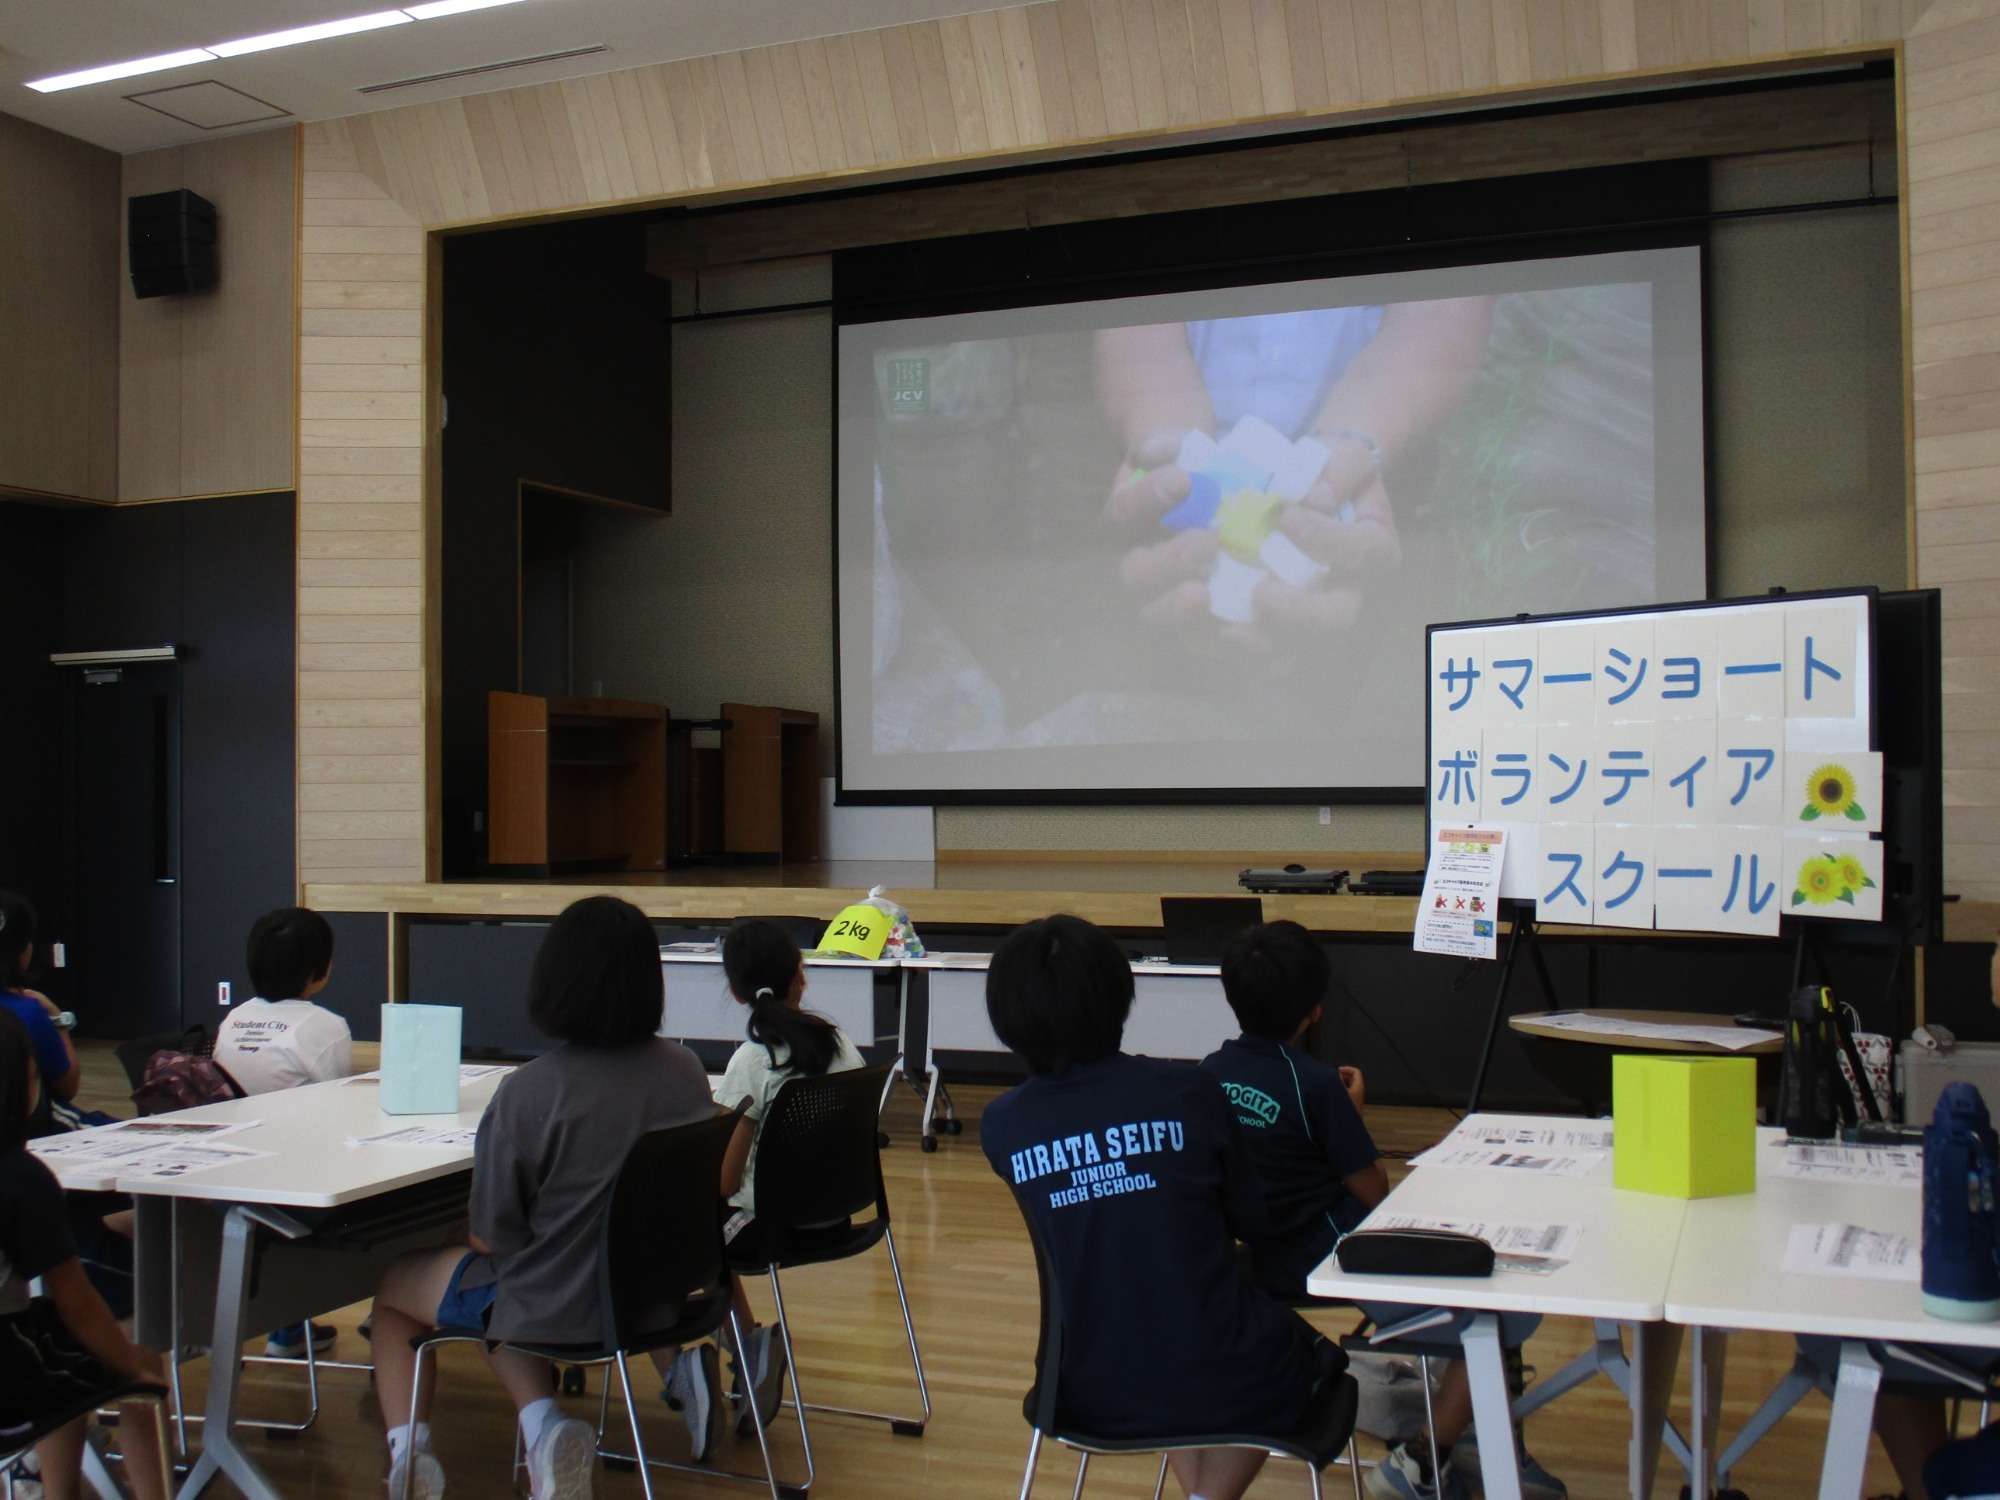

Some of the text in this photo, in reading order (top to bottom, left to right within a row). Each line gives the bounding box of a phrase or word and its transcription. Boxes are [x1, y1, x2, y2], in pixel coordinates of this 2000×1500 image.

[894, 390, 924, 401] JCV
[1439, 636, 1842, 711] サマーショート
[1438, 749, 1775, 808] ボランティア
[1543, 850, 1776, 915] スクール
[232, 1020, 289, 1032] Student City
[1238, 1115, 1266, 1128] CHOOL
[1011, 1121, 1184, 1184] HIRATA SEIFU
[1049, 1173, 1157, 1209] HIGH SCHOOL
[1070, 1161, 1127, 1188] JUNIOR
